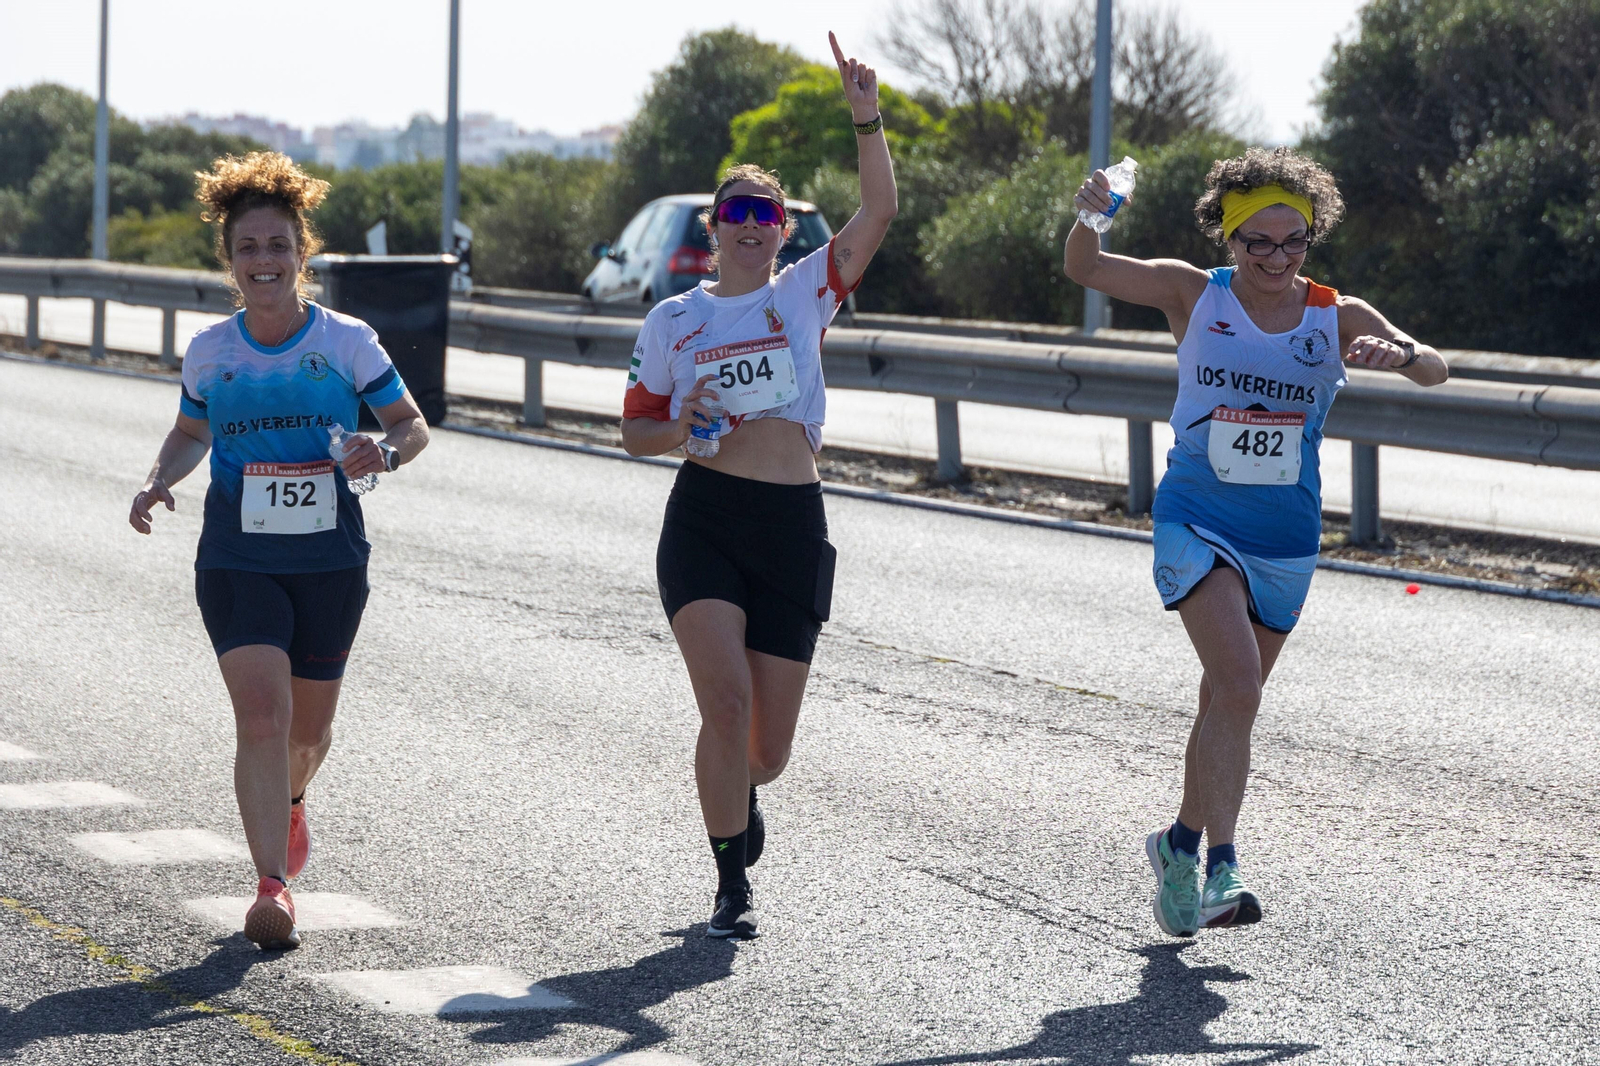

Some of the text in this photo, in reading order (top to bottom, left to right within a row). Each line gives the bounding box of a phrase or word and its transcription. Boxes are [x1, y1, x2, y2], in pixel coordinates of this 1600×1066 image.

[728, 342, 752, 350] MEDIA
[729, 347, 753, 355] BAHÍA
[764, 341, 786, 349] CÁDIZ
[719, 355, 774, 389] 504
[1196, 364, 1315, 404] LOS VEREITAS
[220, 414, 333, 436] LOS VEREITAS
[1231, 429, 1284, 457] 482
[266, 480, 317, 508] 152
